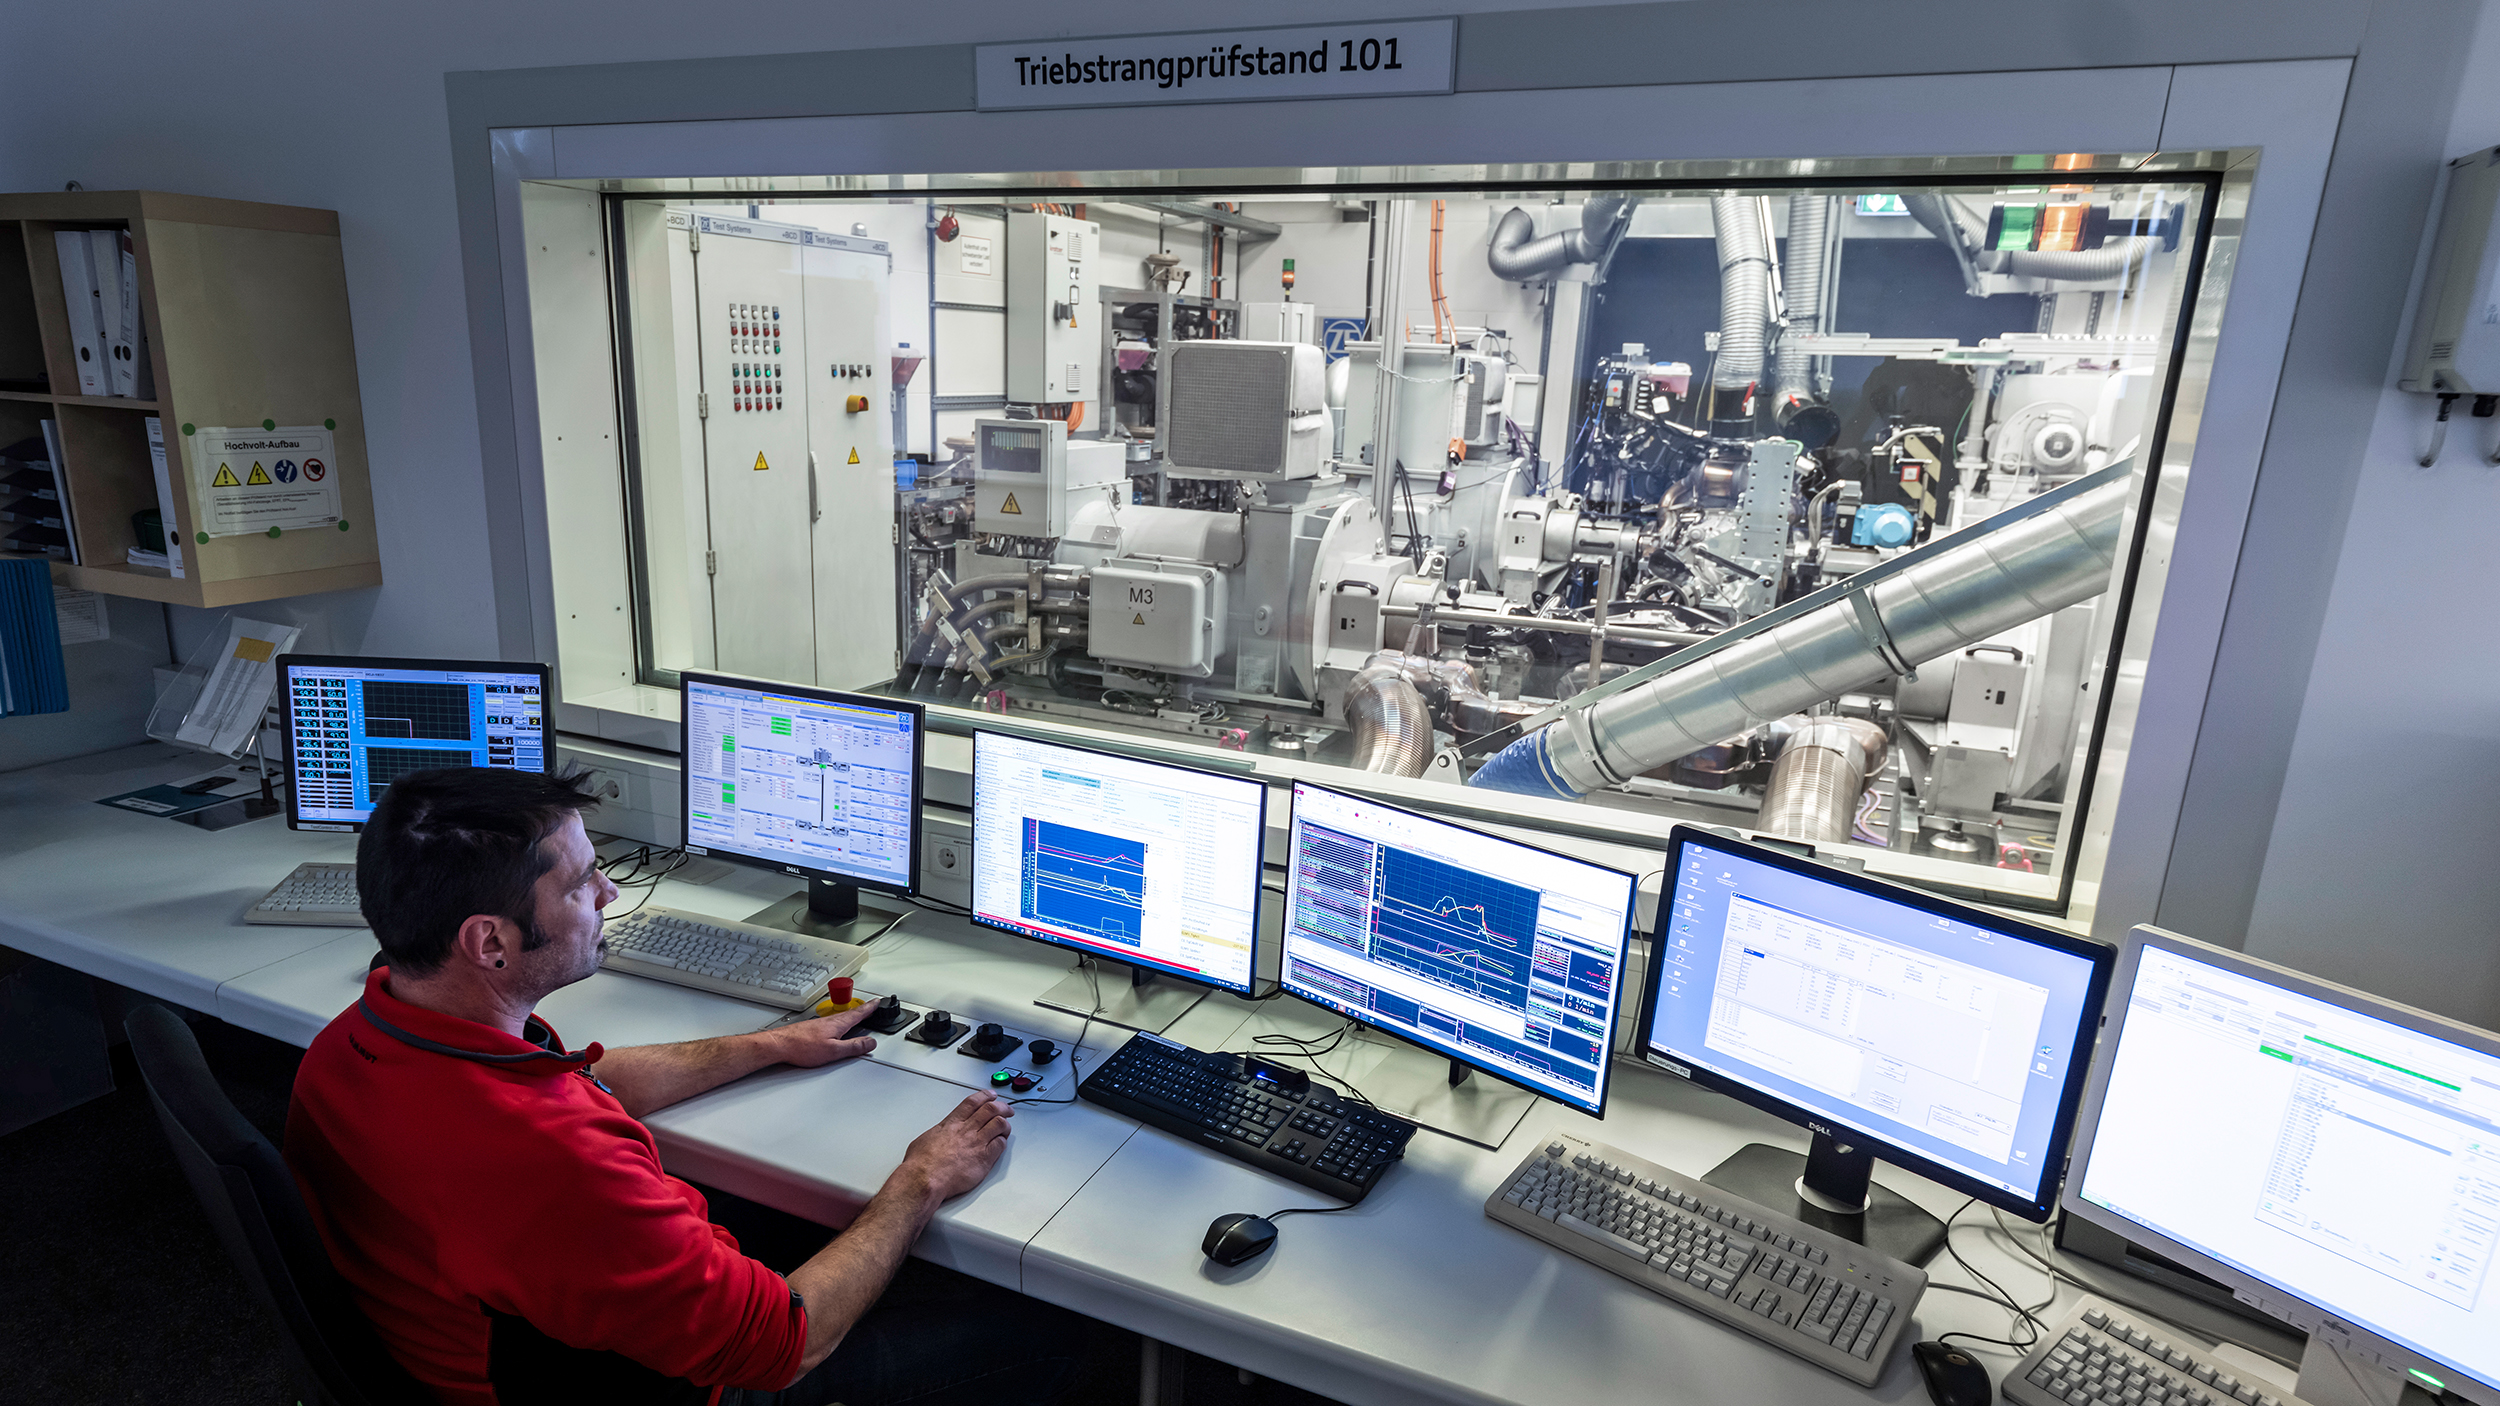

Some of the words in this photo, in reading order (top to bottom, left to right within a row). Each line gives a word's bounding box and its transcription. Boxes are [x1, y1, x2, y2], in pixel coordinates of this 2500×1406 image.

[1014, 39, 1329, 90] Triebstrangprüfstand
[1339, 37, 1403, 72] 101
[712, 222, 725, 230] Test
[726, 224, 752, 234] Systems
[814, 235, 826, 244] Test
[826, 237, 847, 246] Systems
[224, 440, 300, 450] Hochvolt-Aufbau
[1130, 587, 1153, 604] M3
[1809, 1122, 1831, 1136] DELL
[1561, 1134, 1583, 1144] CHERRY
